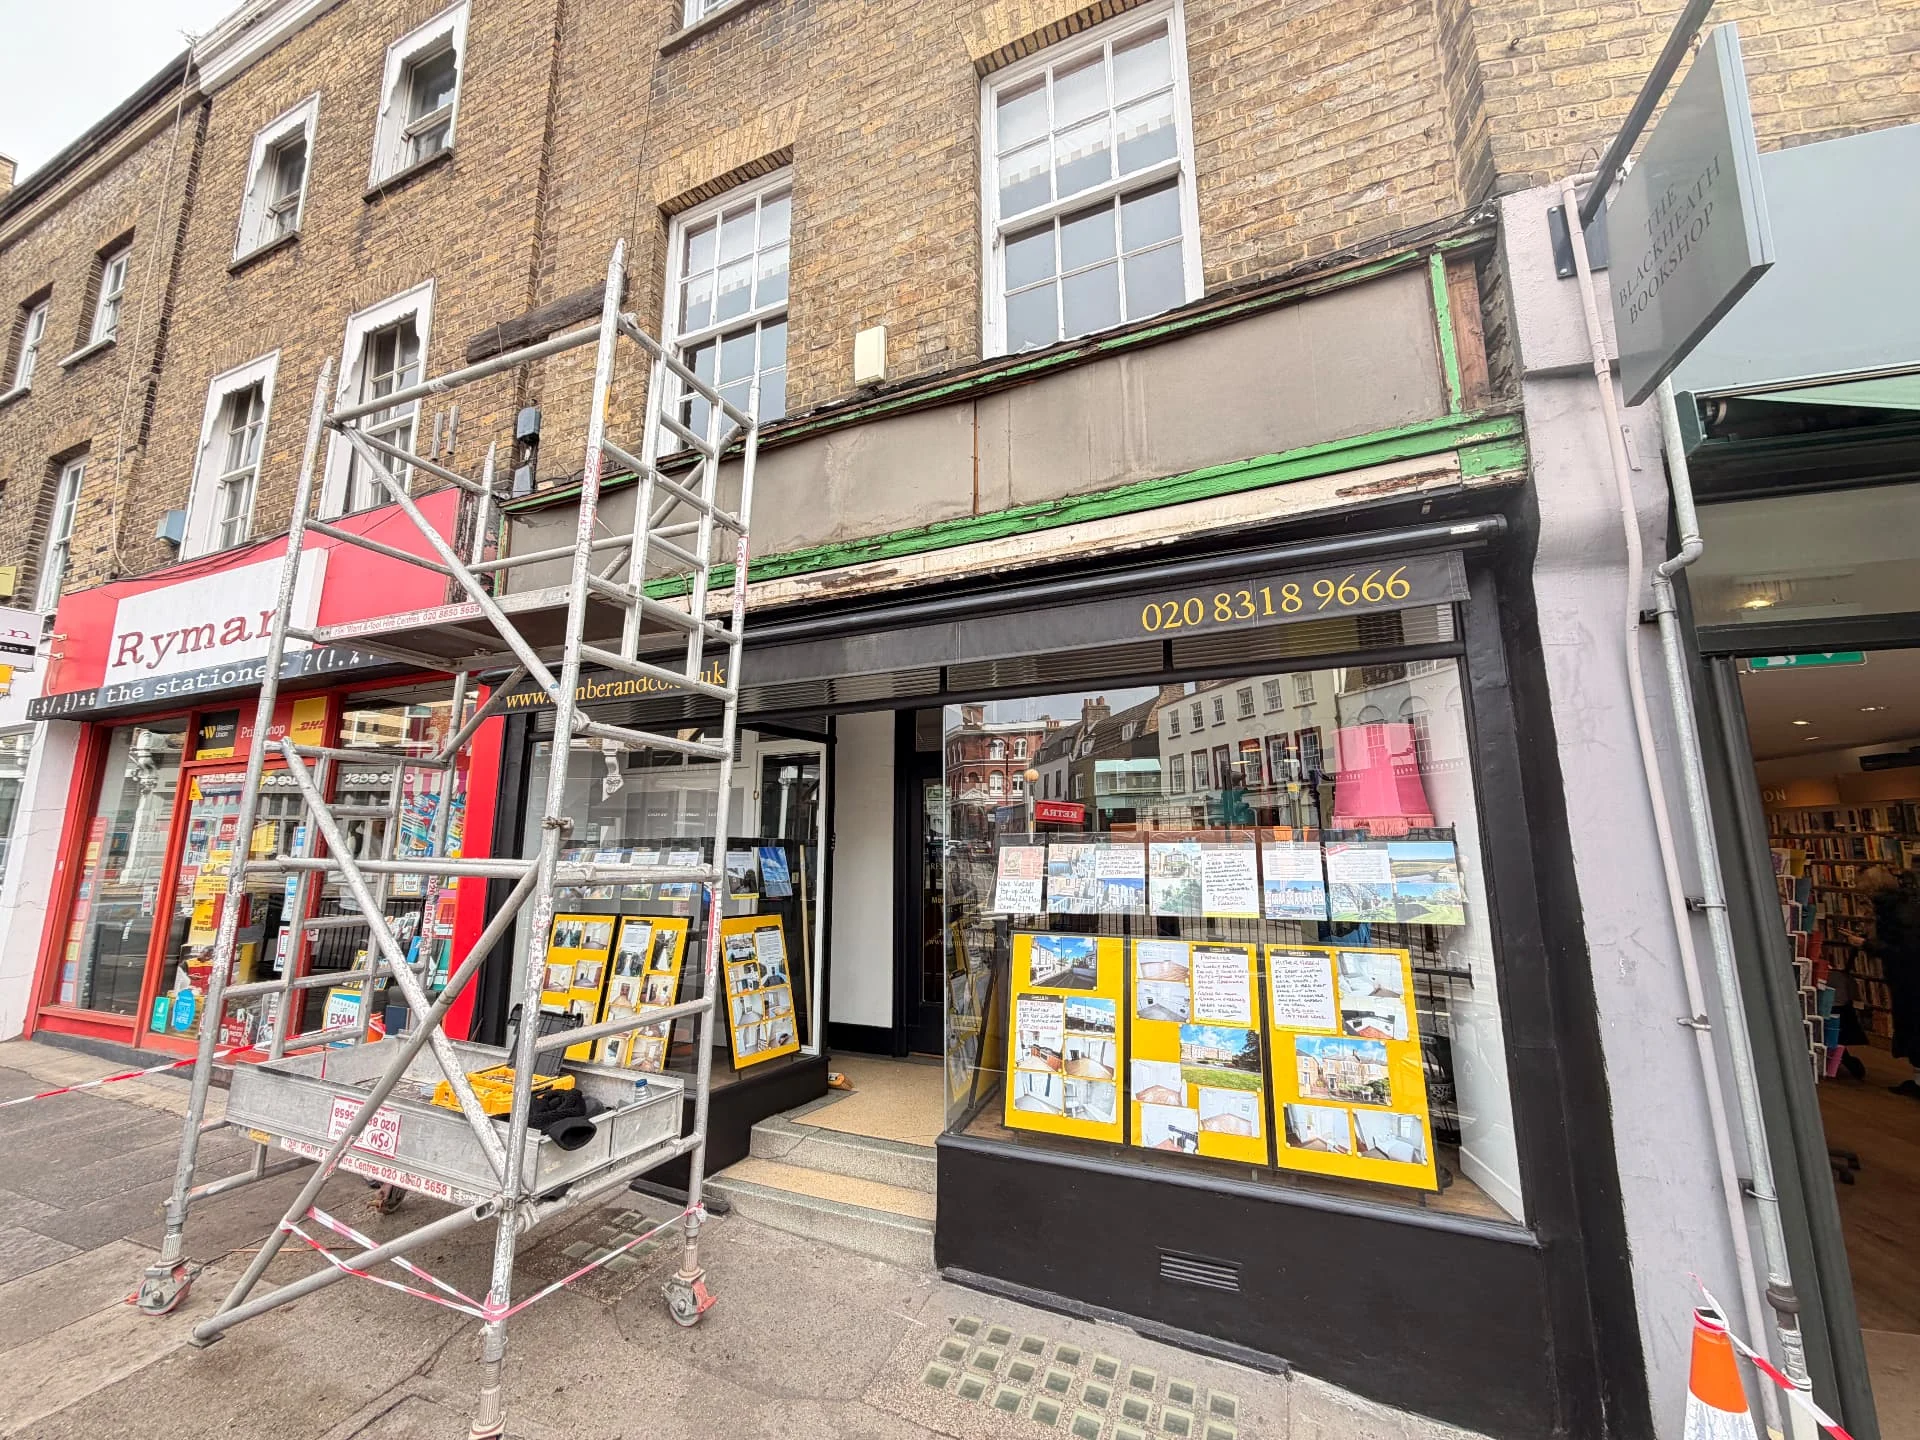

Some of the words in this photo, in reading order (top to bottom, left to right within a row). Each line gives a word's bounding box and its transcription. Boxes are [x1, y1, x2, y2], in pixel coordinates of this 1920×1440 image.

[1644, 184, 1677, 235] THE
[1619, 155, 1720, 308] BLACKHEATH
[1629, 202, 1714, 324] BOOKSHOP
[1142, 597, 1204, 632] 020
[1213, 583, 1303, 622] 8318
[1312, 566, 1411, 611] 9666
[422, 611, 437, 621] 020
[0, 628, 32, 640] n
[106, 685, 135, 704] the
[330, 1012, 355, 1025] EXAM
[334, 1107, 355, 1121] 5658
[380, 1119, 396, 1133] 020
[370, 1132, 390, 1151] PSM
[354, 1158, 379, 1175] Centres
[381, 1167, 398, 1182] 020
[423, 1180, 448, 1196] 5658
